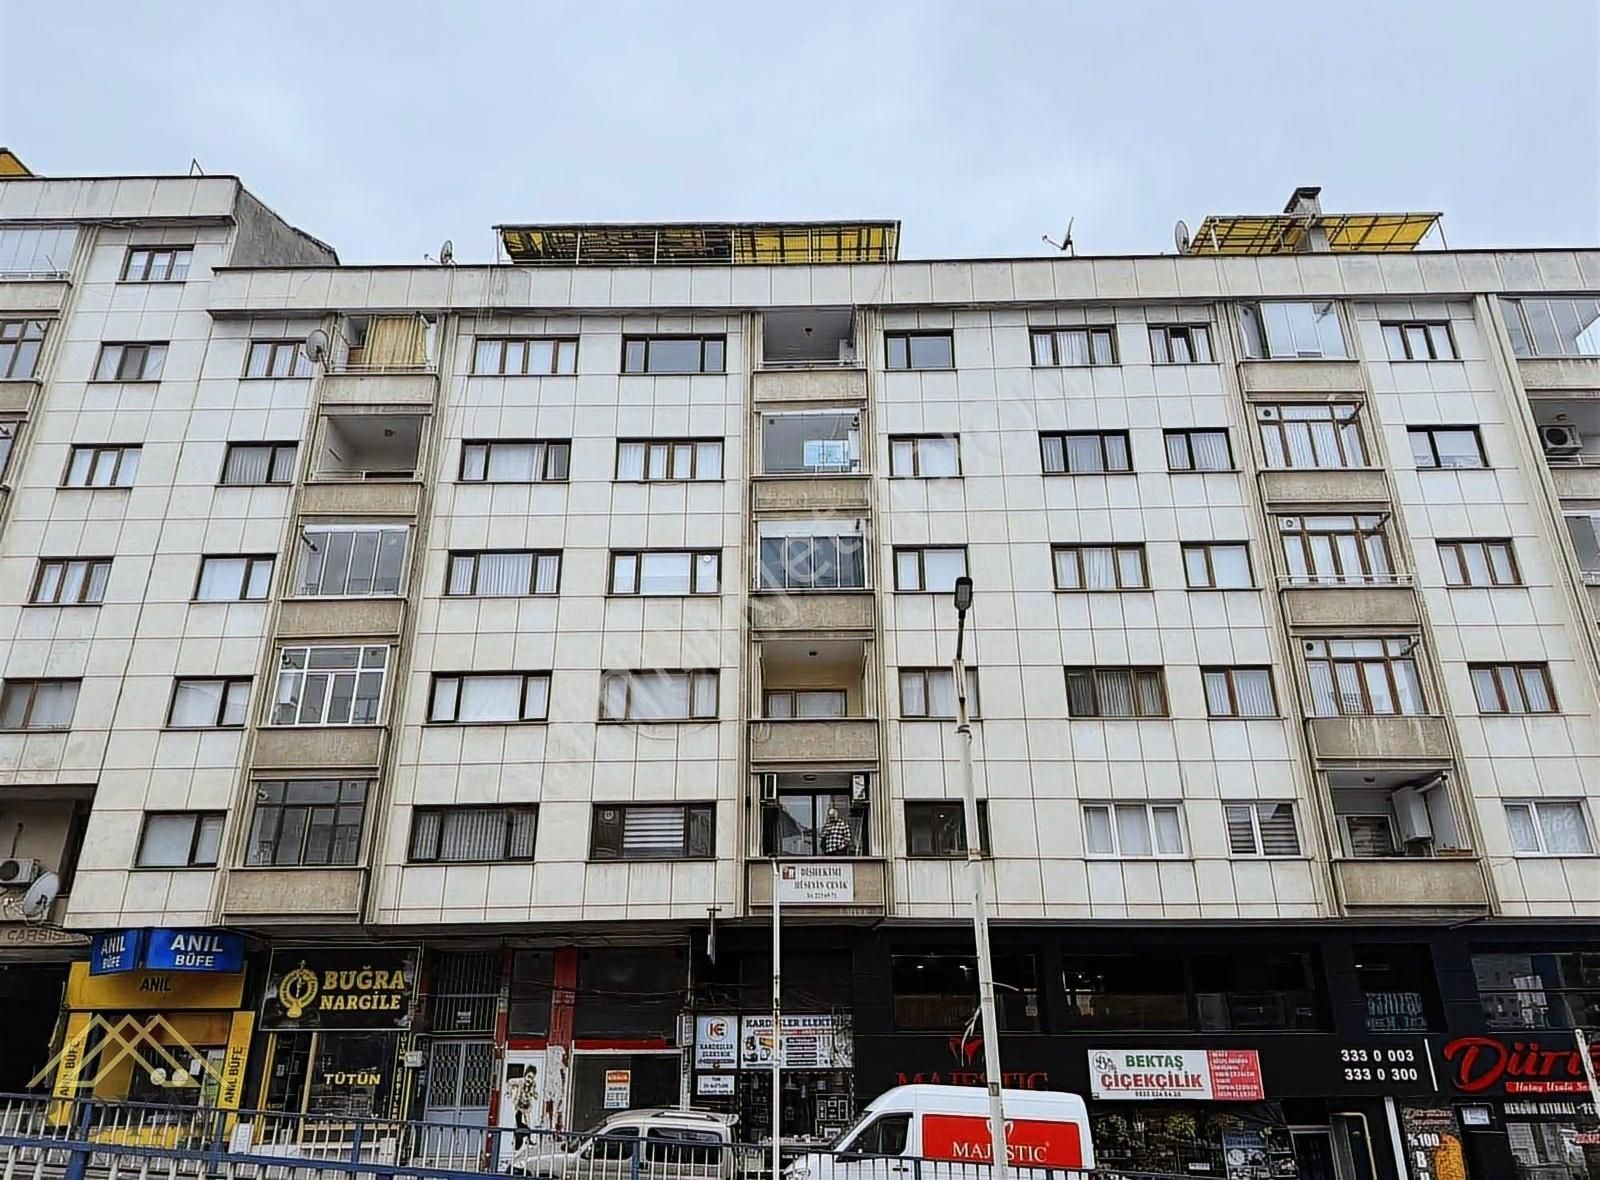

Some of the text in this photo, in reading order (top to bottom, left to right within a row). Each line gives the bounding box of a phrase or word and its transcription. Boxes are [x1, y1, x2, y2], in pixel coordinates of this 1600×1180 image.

[100, 935, 126, 955] ANIL
[170, 934, 223, 952] ANIL
[174, 953, 214, 967] BÜFE
[139, 977, 172, 992] ANIL
[322, 965, 405, 990] BUĞRA
[319, 991, 401, 1010] NARGİLE
[746, 1019, 800, 1028] KARDLER
[1125, 1055, 1184, 1071] BEKTAŞ
[1340, 1049, 1414, 1062] 333 0 003
[224, 1046, 244, 1104] ANIL BÜFE
[323, 1071, 381, 1085] TÜTÜN
[1101, 1071, 1203, 1090] ÇİÇEKÇİLİK
[1344, 1068, 1418, 1080] 333 0 300
[1408, 1133, 1440, 1147] %100
[953, 1141, 1047, 1162] MAJSTIC
